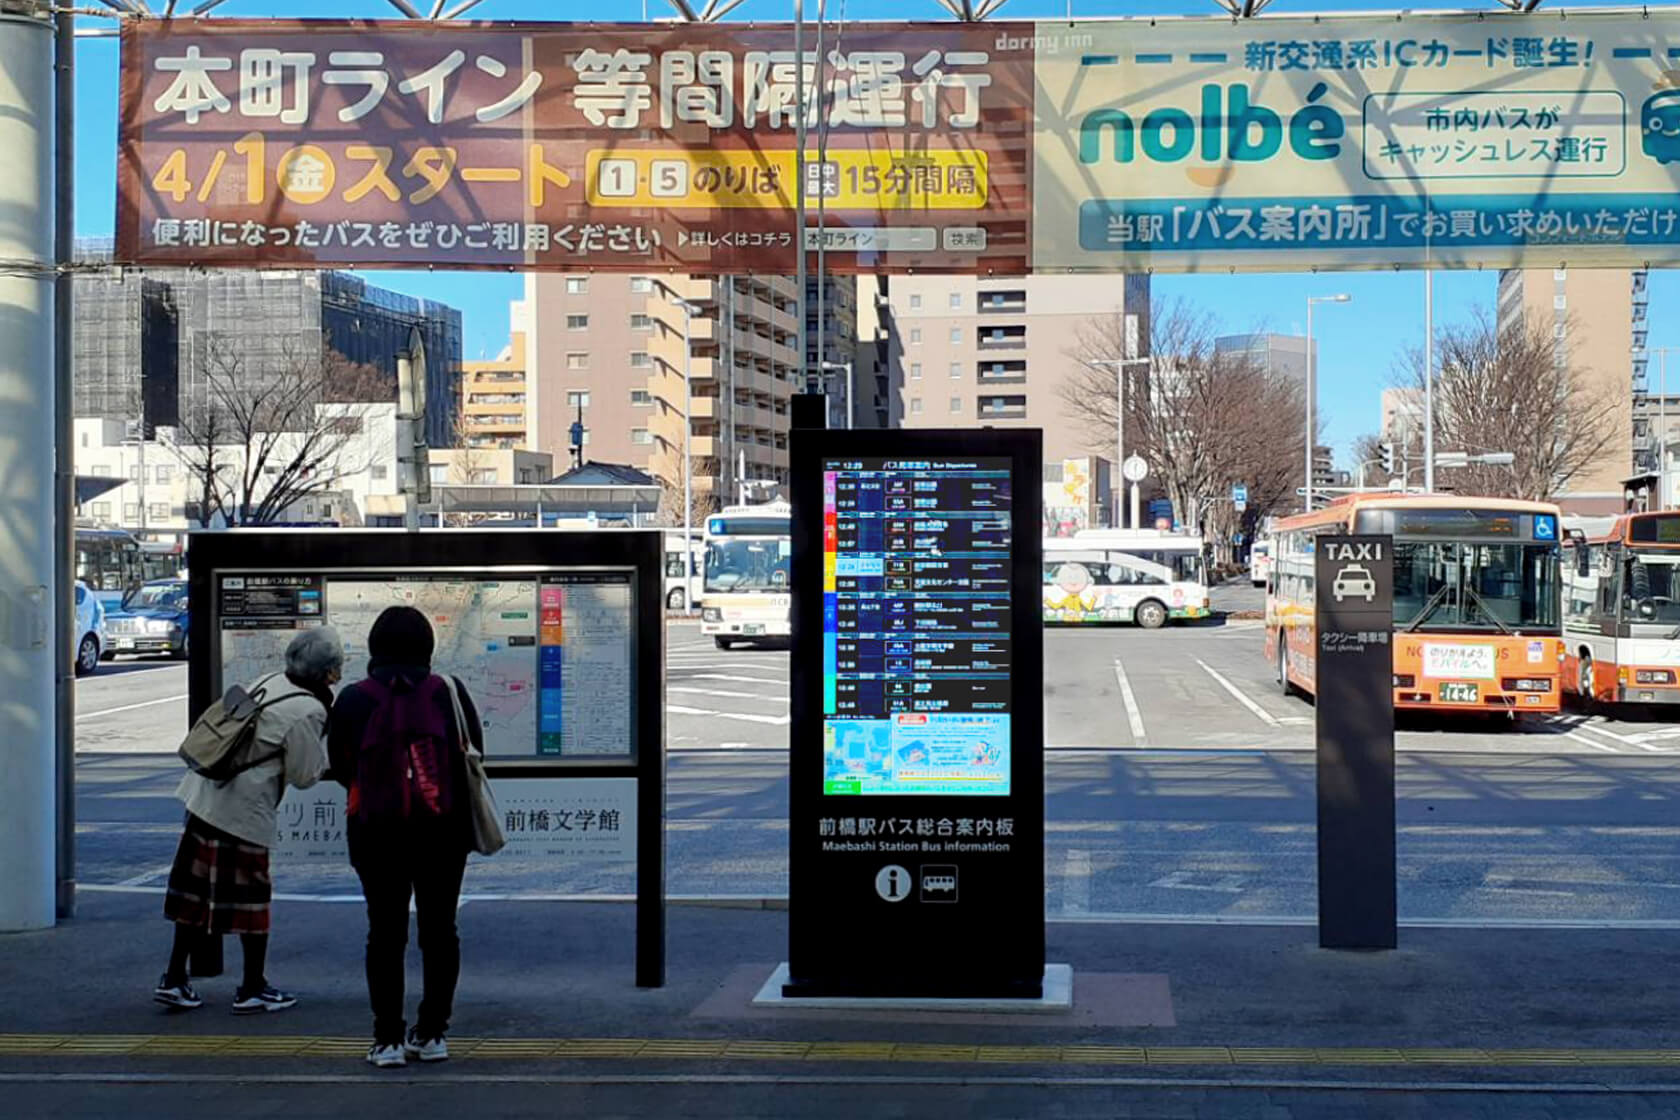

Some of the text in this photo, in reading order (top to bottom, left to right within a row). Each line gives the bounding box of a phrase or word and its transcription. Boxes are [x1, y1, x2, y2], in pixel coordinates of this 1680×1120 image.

[154, 46, 993, 129] 本町ライン 等間隔運行
[1078, 82, 1345, 165] nolbé
[1425, 106, 1560, 131] 市内バスが
[1378, 137, 1608, 164] キャッシュレス運行
[846, 164, 976, 195] 15分間隔
[153, 219, 661, 253] 便利になったバスをぜひご利用ください
[690, 231, 791, 247] 詳しくはコチラ
[807, 232, 873, 246] 本町ライン
[1325, 543, 1382, 561] TAXI
[505, 807, 621, 832] 前橋文学館
[818, 817, 1014, 836] 前橋駅バス総合案内板
[822, 840, 876, 852] Maebashi
[879, 840, 919, 852] Station
[921, 841, 941, 852] Bus
